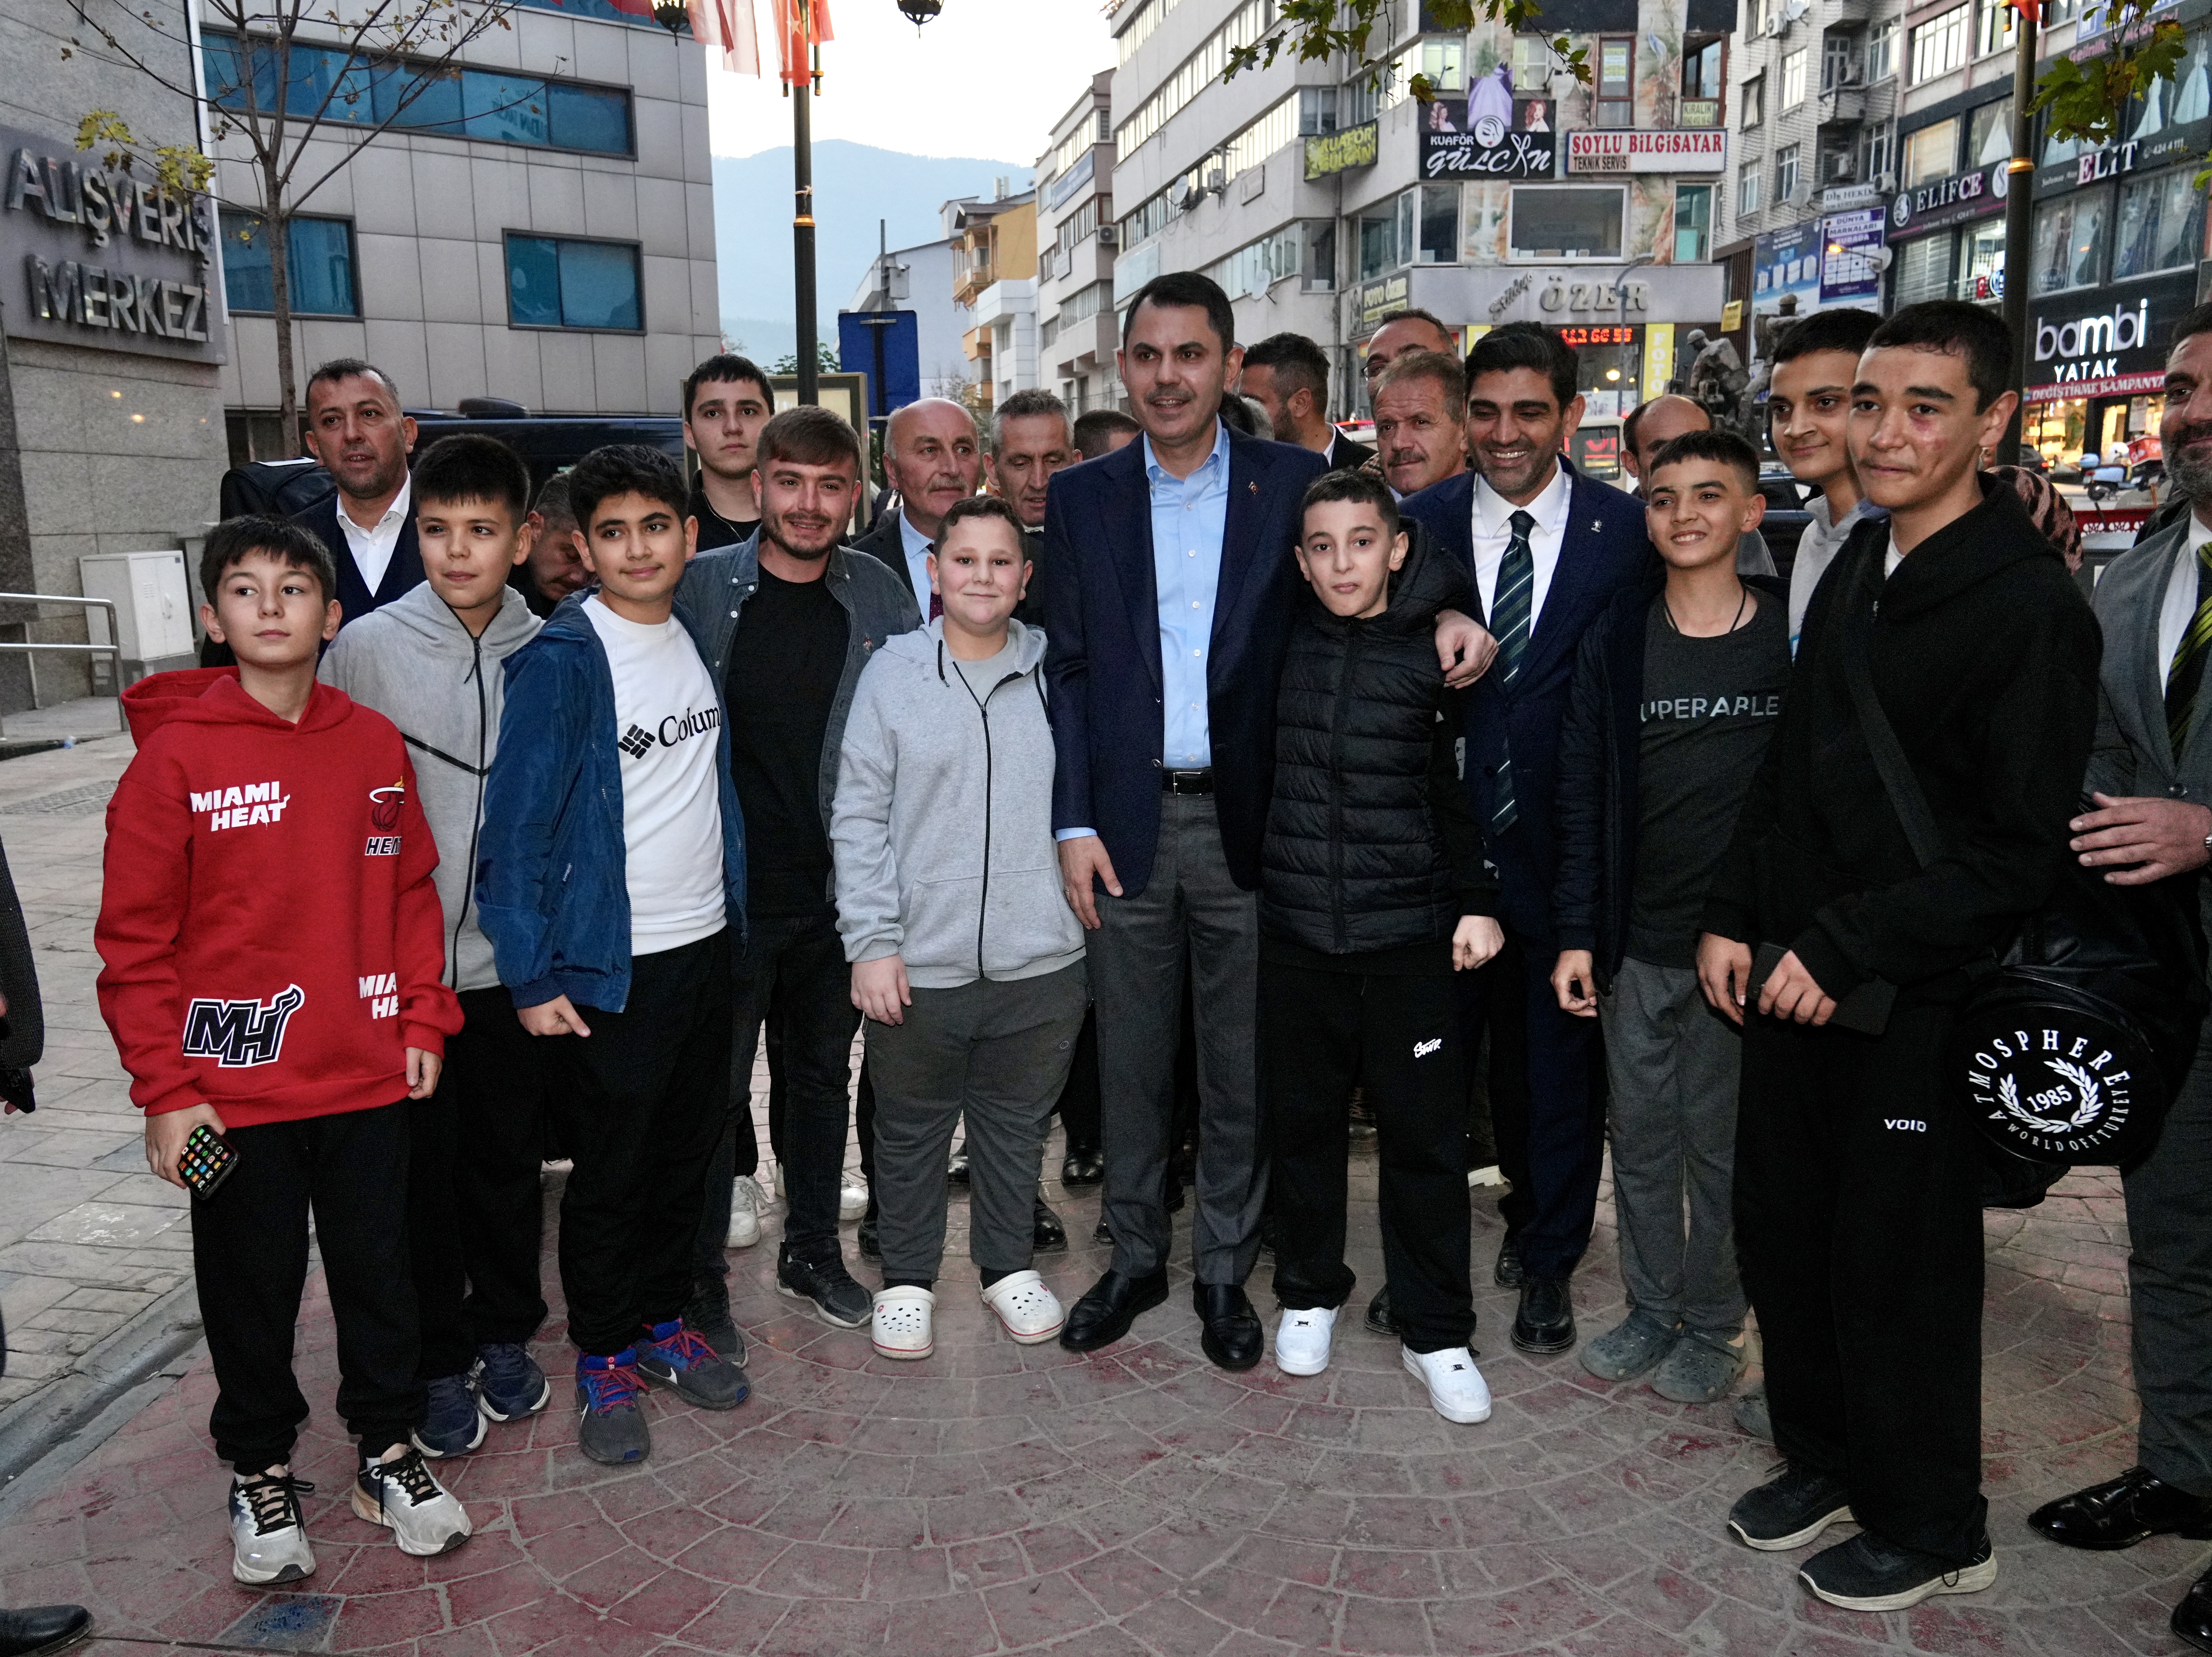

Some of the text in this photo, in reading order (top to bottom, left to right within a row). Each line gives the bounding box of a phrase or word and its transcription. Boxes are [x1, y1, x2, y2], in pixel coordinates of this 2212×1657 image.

[1430, 131, 1475, 146] KUAFÖR
[1572, 134, 1623, 154] SOYLU
[1916, 171, 1986, 213] ELİFCE
[1830, 223, 1877, 235] MARKALARI
[1836, 215, 1864, 225] DÜNYA
[24, 254, 212, 342] MERKEZ
[1540, 275, 1648, 312] ÖZER
[2035, 298, 2148, 362] bambi
[1649, 332, 1666, 392] FOTO
[2055, 357, 2117, 383] YATAK
[659, 697, 721, 747] Colum
[190, 781, 280, 812] MIAMI
[211, 794, 291, 832] HEAT
[182, 983, 305, 1067] MH
[1968, 1029, 2131, 1120] ATMOSPHERE
[2026, 1084, 2072, 1112] 1985
[1884, 1119, 1926, 1132] VOID
